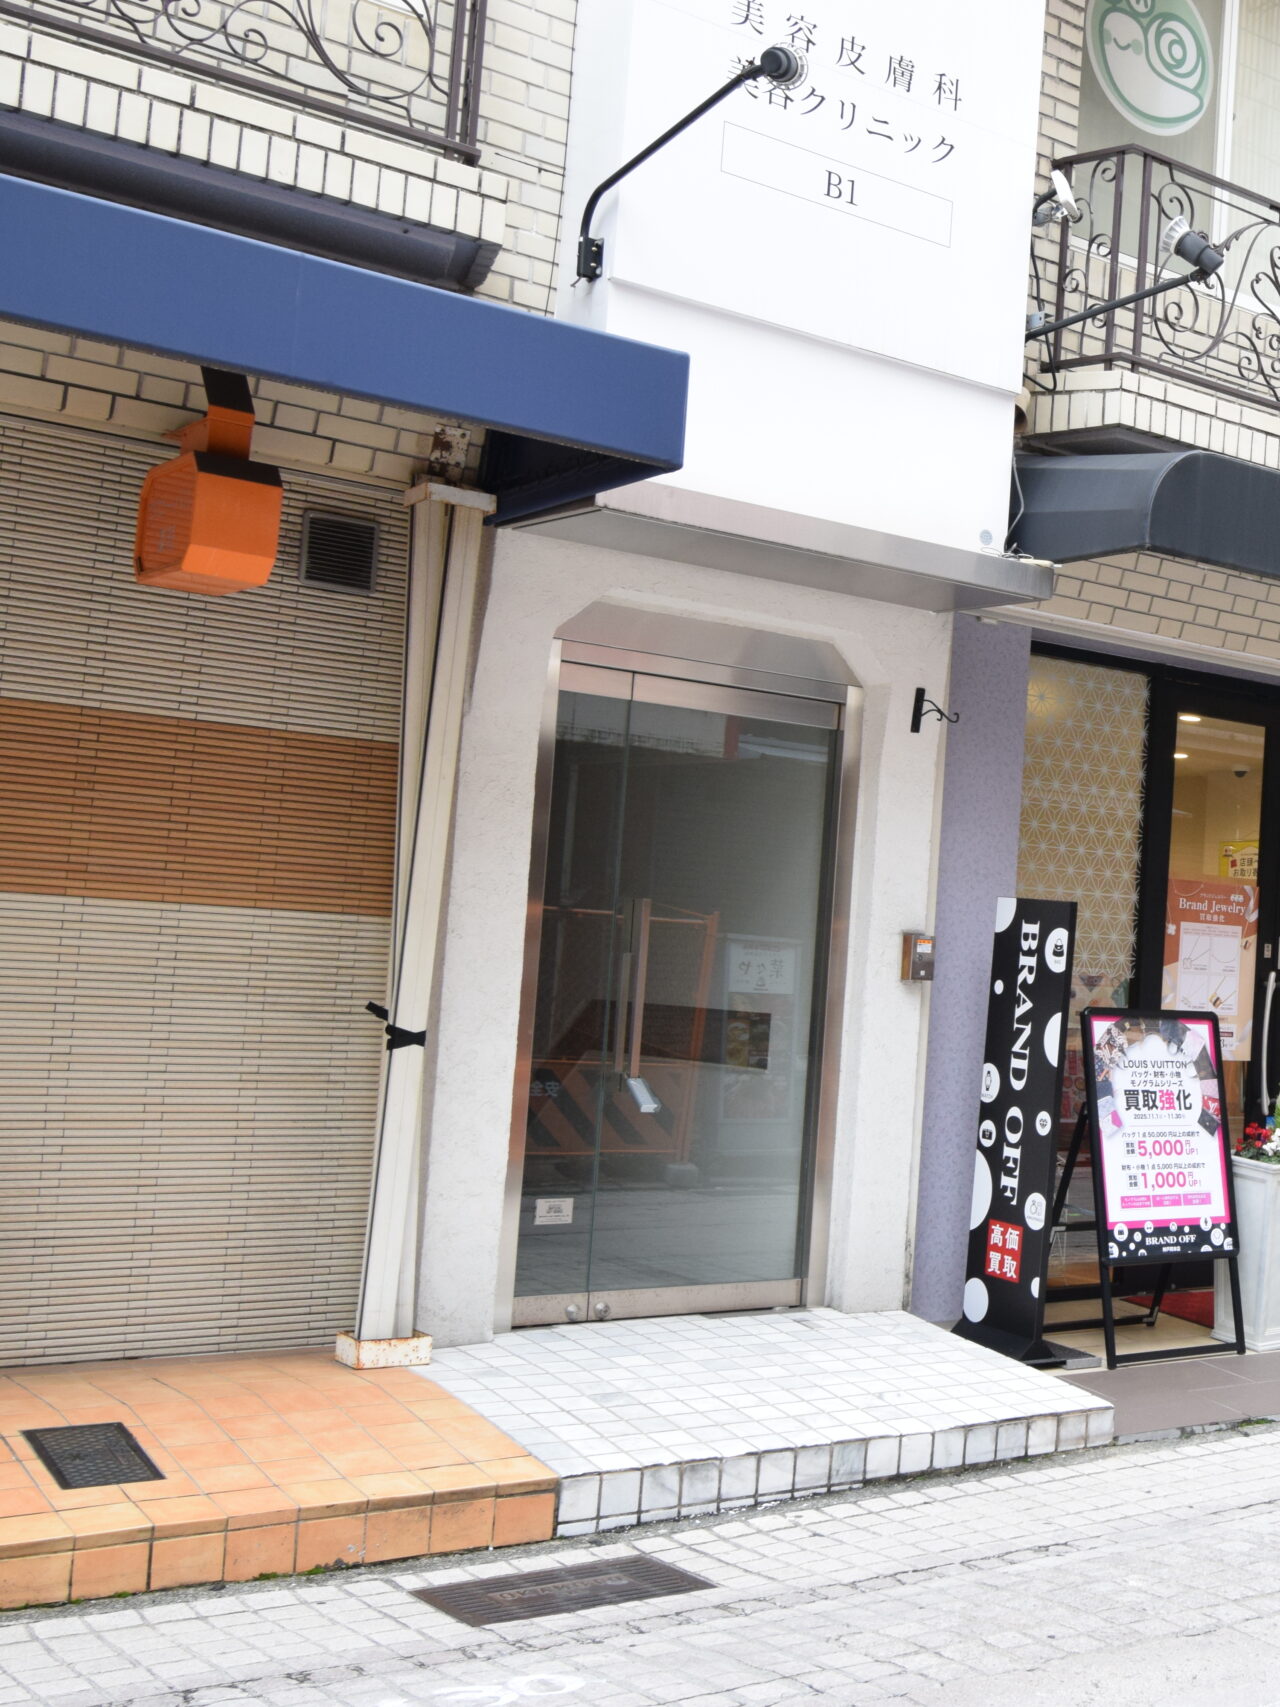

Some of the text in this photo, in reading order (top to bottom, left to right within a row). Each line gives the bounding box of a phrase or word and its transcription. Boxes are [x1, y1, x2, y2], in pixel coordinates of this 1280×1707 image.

[731, 0, 962, 111] 美容皮膚科
[824, 169, 858, 206] B1
[1179, 898, 1246, 915] Brand Jewelry
[1010, 920, 1040, 1091] BRAND
[1123, 1060, 1187, 1069] LOUIS VUITTON
[1124, 1089, 1192, 1111] 買取強化
[1000, 1106, 1023, 1205] OFF
[1138, 1140, 1184, 1159] 5,000
[1141, 1171, 1186, 1191] 1,000
[991, 1224, 1020, 1251] 高価
[1145, 1234, 1197, 1246] BRAND OFF
[988, 1251, 1017, 1279] 買取
